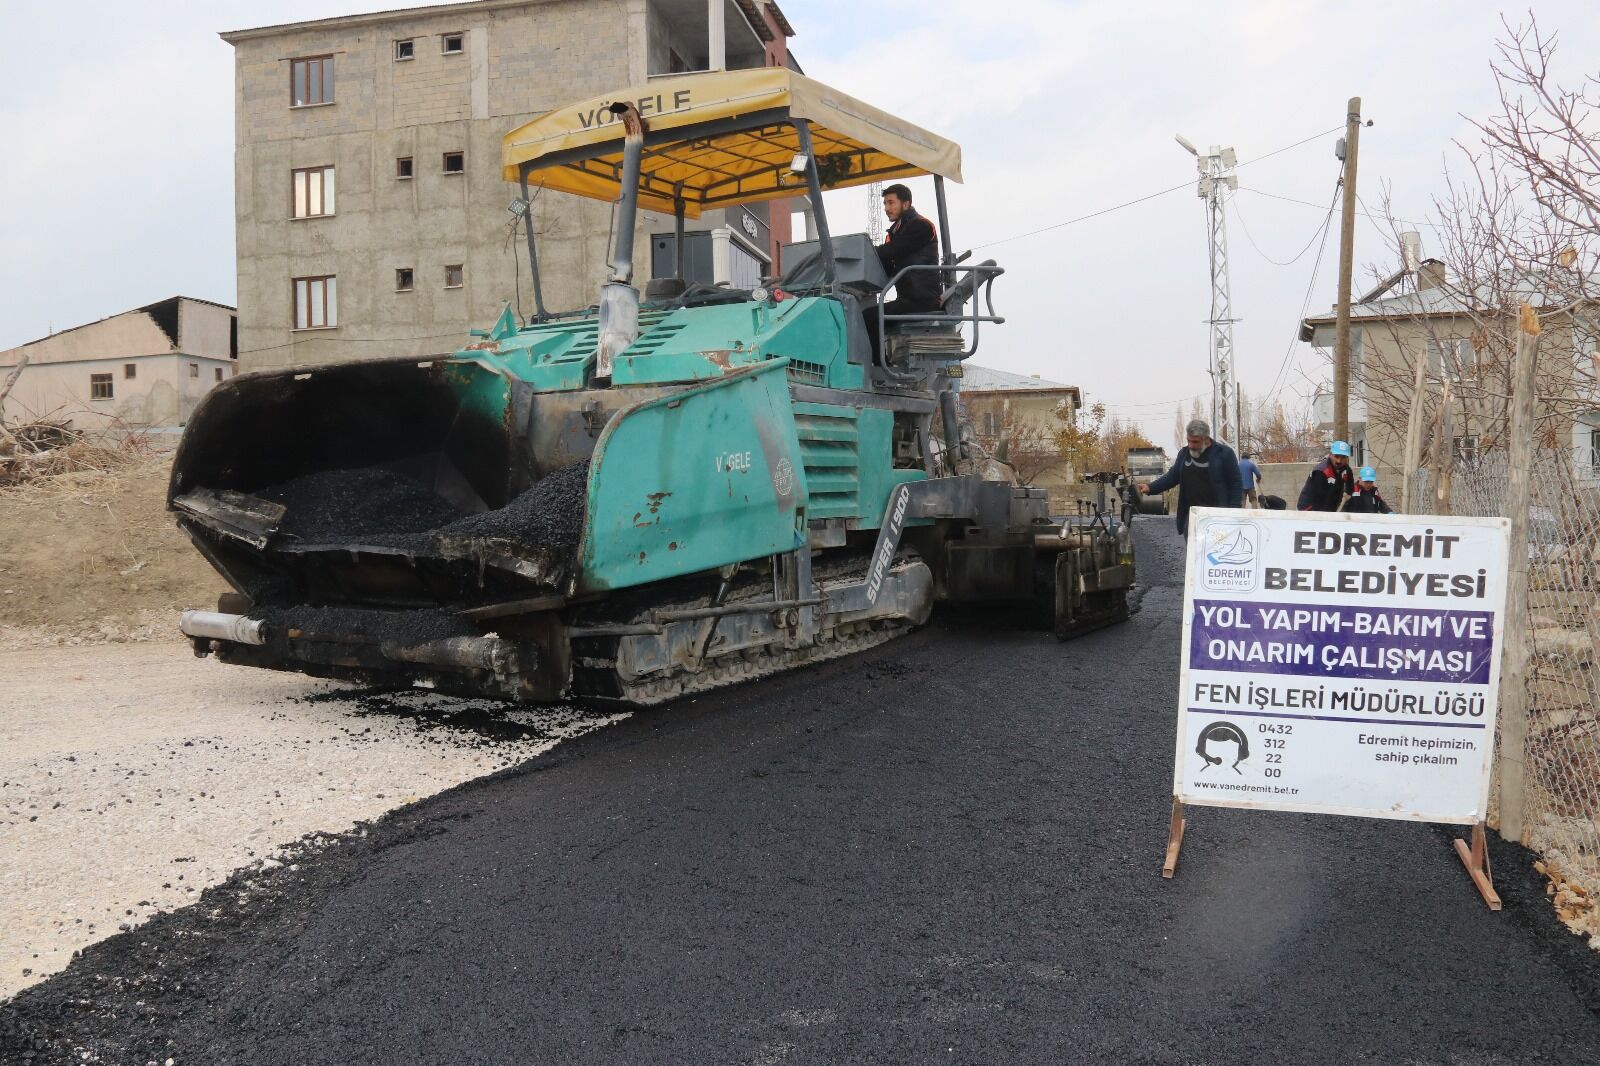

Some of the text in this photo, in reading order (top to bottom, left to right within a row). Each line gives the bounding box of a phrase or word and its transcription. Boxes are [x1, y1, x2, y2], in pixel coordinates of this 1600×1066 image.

[867, 485, 910, 605] SUPER 1900
[1293, 528, 1460, 559] EDREMİT
[1208, 568, 1252, 579] EDREMİT
[1264, 565, 1487, 599] BELEDİYESİ
[1200, 606, 1488, 639] YOL YAPIM-BAKIM VE
[1208, 639, 1473, 674] ONARIM ÇALIŞMASI
[1195, 681, 1485, 717] FEN İŞLERİ MÜDÜRLÜĞÜ
[1258, 723, 1293, 735] 0432
[1264, 738, 1286, 749] 312
[1358, 734, 1477, 751] Edremit hepimizin,
[1265, 753, 1282, 763] 22
[1375, 752, 1458, 765] sahip çıkalım
[1264, 768, 1281, 778] 00
[1193, 781, 1299, 795] www.vanedremit.bel.tr
